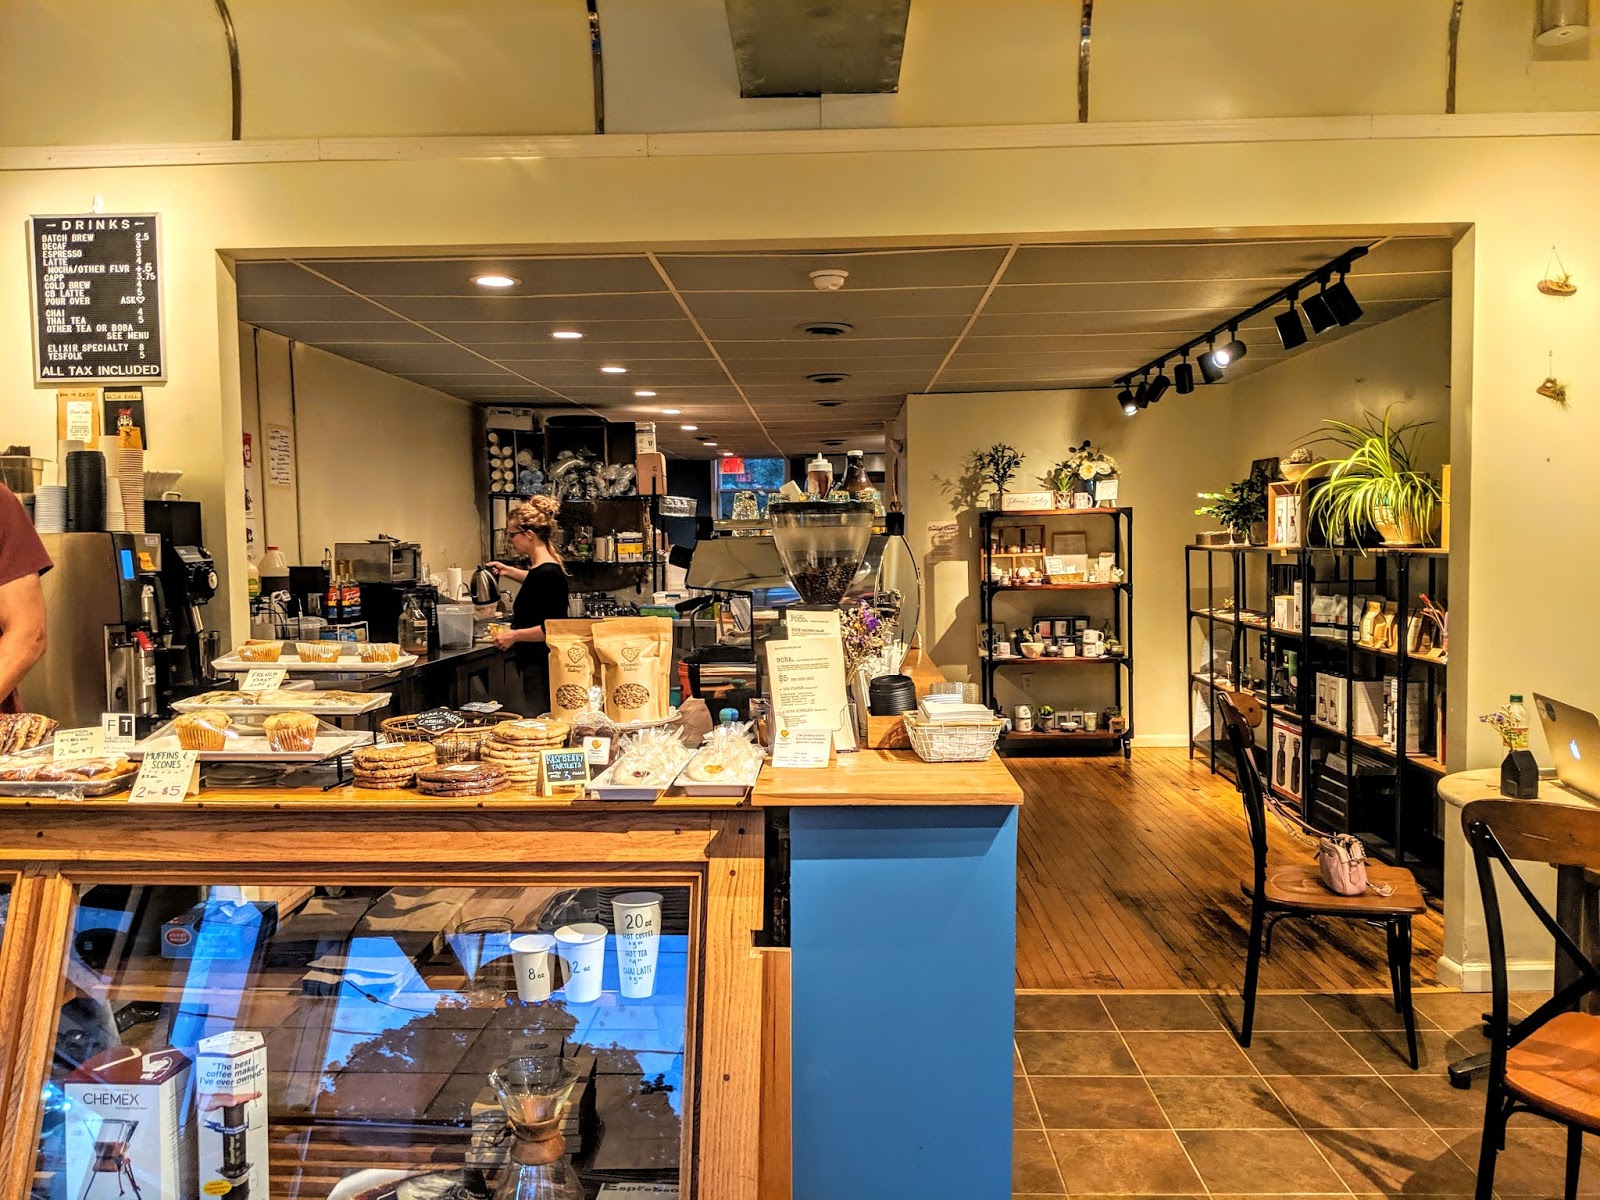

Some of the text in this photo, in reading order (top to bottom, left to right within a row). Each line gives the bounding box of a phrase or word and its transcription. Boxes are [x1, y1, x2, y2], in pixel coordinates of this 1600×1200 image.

[62, 220, 130, 230] DRINKS
[42, 234, 67, 242] BATCH
[110, 265, 129, 273] FLVR
[44, 274, 64, 282] CAPP
[45, 282, 64, 290] COLD
[46, 298, 66, 306] POUR
[70, 297, 90, 305] OVER
[46, 317, 65, 325] THAI
[47, 325, 72, 333] OTHER
[107, 331, 149, 340] SEE MENU
[48, 344, 81, 352] ELIXIR
[139, 343, 144, 351] 8
[48, 352, 82, 360] YESFOLK
[42, 365, 159, 376] ALL TAX INCLUDED
[145, 752, 179, 760] MUFFINS
[546, 753, 583, 764] RASPBERRY
[151, 760, 181, 769] SCONES
[135, 787, 146, 798] 2
[161, 785, 181, 796] $5
[625, 914, 643, 929] 20
[635, 930, 653, 940] COFFEE
[638, 949, 648, 957] TEA
[566, 960, 580, 973] 12
[528, 968, 536, 980] 8
[213, 1058, 251, 1070] "The best
[234, 1064, 259, 1077] maker
[200, 1077, 214, 1085] I've
[236, 1067, 265, 1084] owned."
[82, 1092, 140, 1105] CHEMEX
